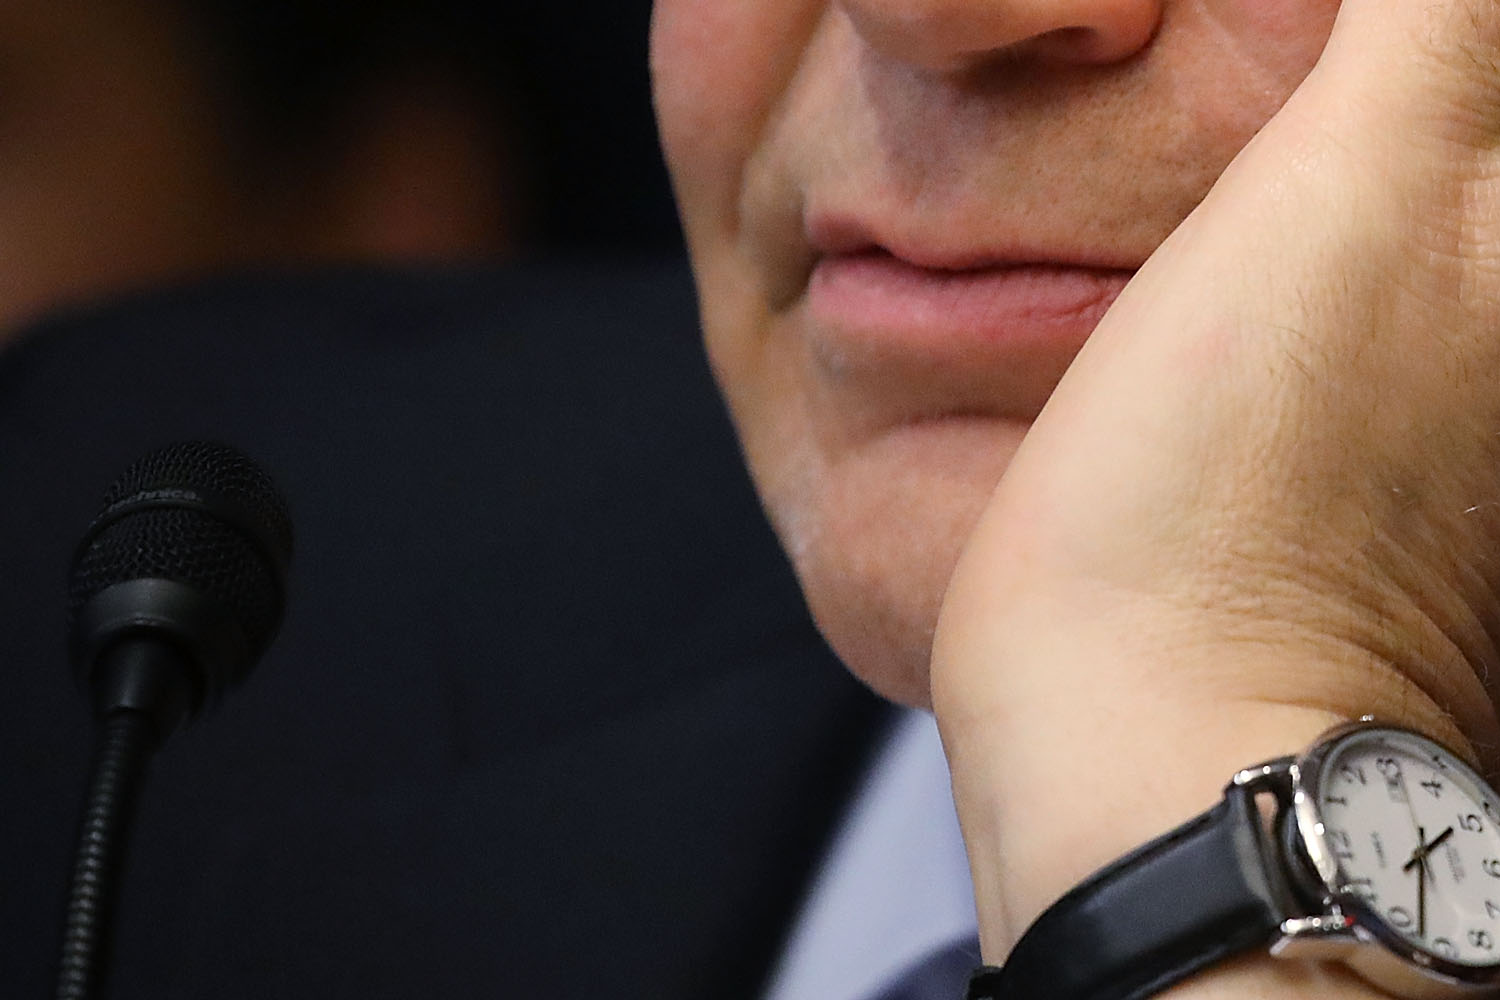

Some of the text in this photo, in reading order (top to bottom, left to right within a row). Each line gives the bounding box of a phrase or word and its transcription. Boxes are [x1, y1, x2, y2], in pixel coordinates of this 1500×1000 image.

[1340, 763, 1366, 785] 2
[1376, 758, 1401, 779] 3
[1421, 781, 1441, 798] 4
[1457, 813, 1482, 832] 5
[1433, 937, 1459, 959] 9
[1467, 929, 1493, 950] 8
